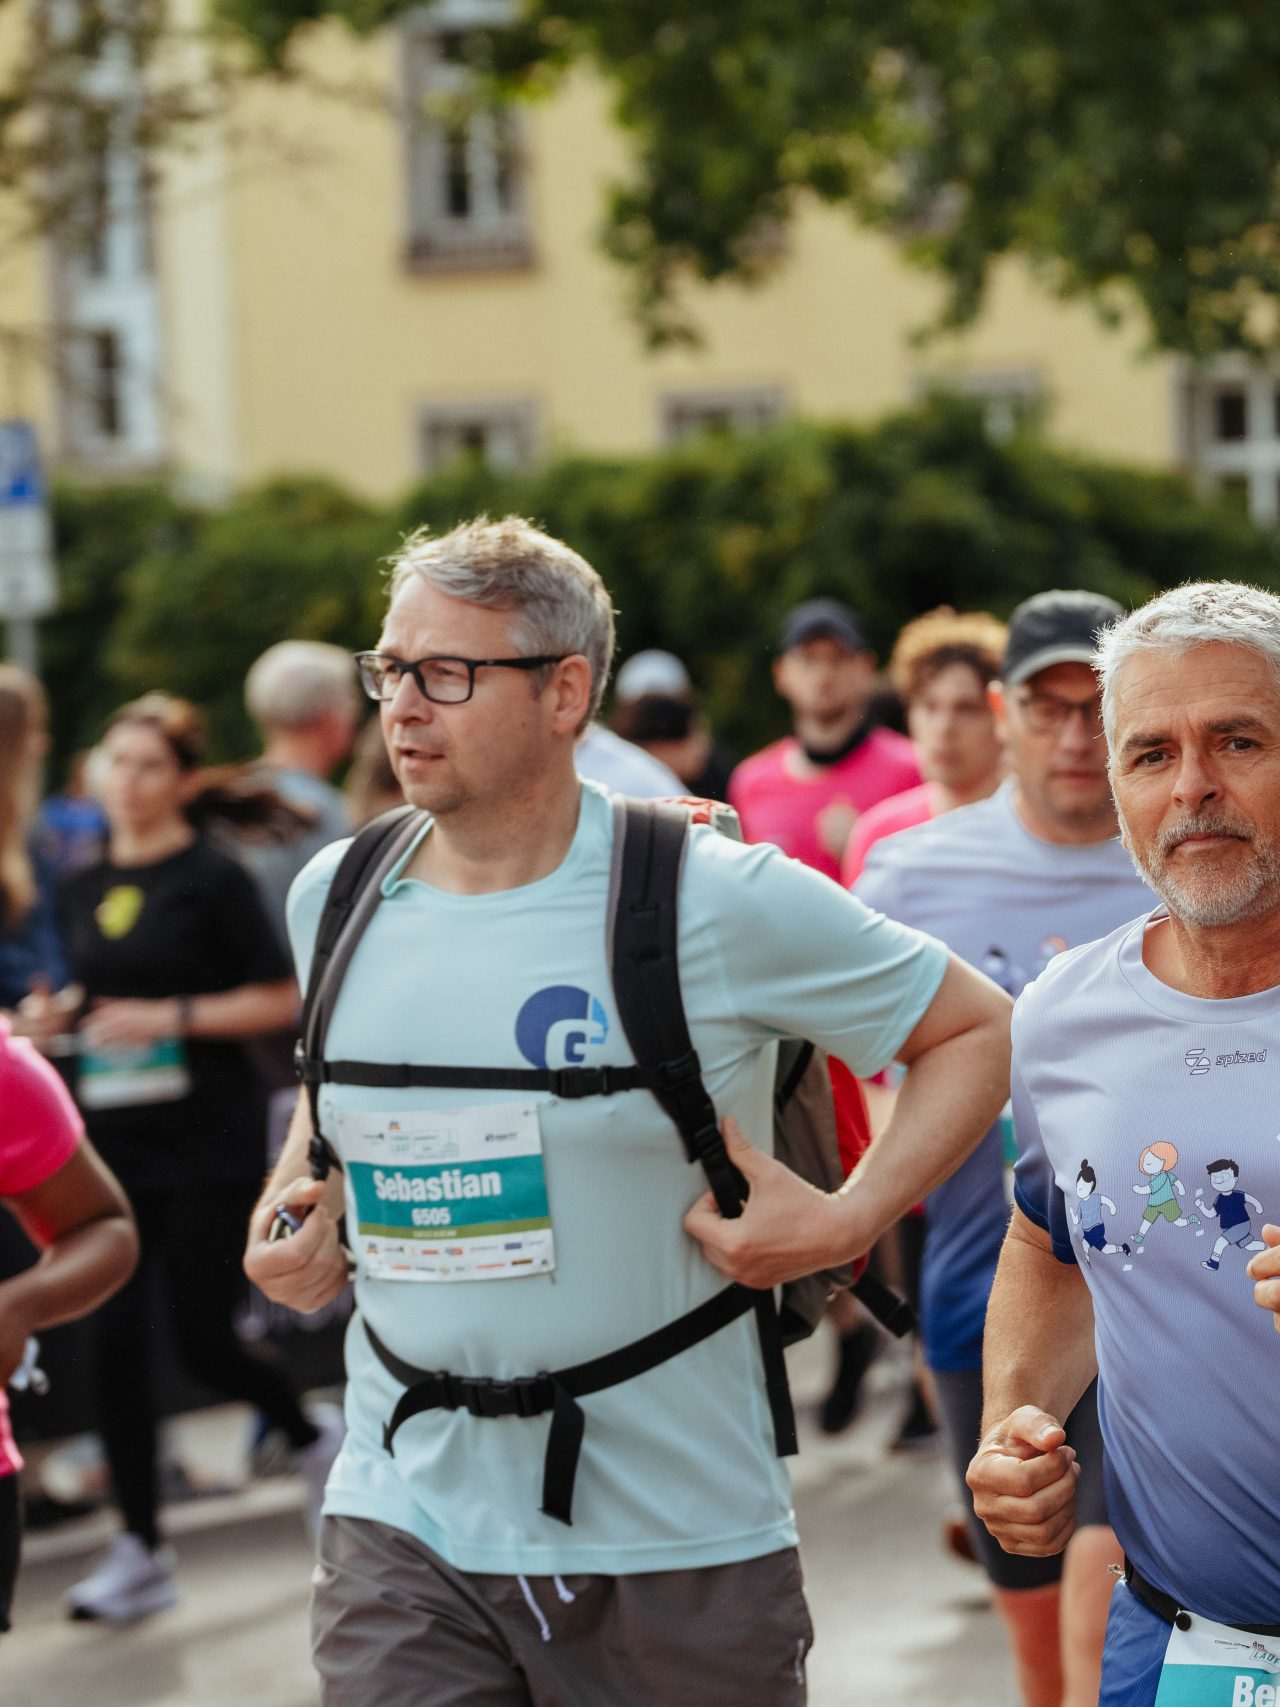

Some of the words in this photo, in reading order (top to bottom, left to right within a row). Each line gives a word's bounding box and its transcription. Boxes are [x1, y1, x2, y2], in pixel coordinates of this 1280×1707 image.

[1215, 1049, 1267, 1068] spized
[373, 1169, 502, 1202] Sebastian
[411, 1207, 452, 1227] 6505
